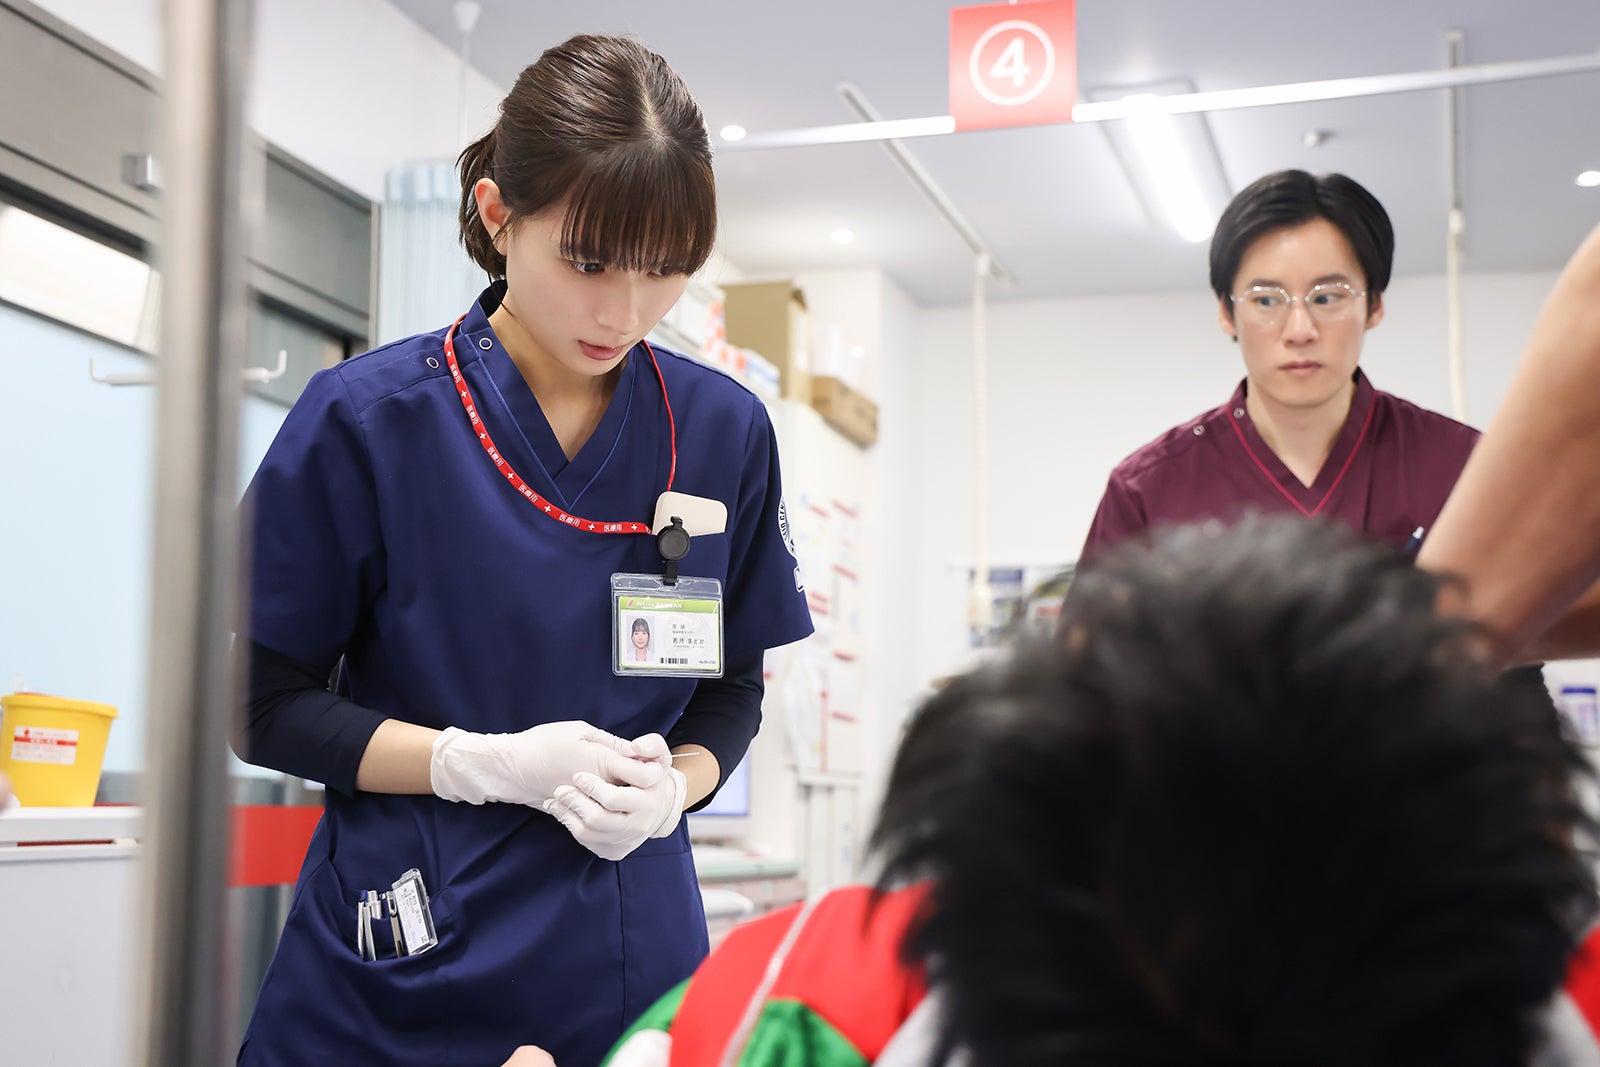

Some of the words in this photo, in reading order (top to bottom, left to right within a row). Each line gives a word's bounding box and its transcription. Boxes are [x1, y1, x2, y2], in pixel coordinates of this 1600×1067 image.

[989, 37, 1031, 88] 4
[518, 484, 538, 503] 医療用
[558, 513, 581, 528] 医療用
